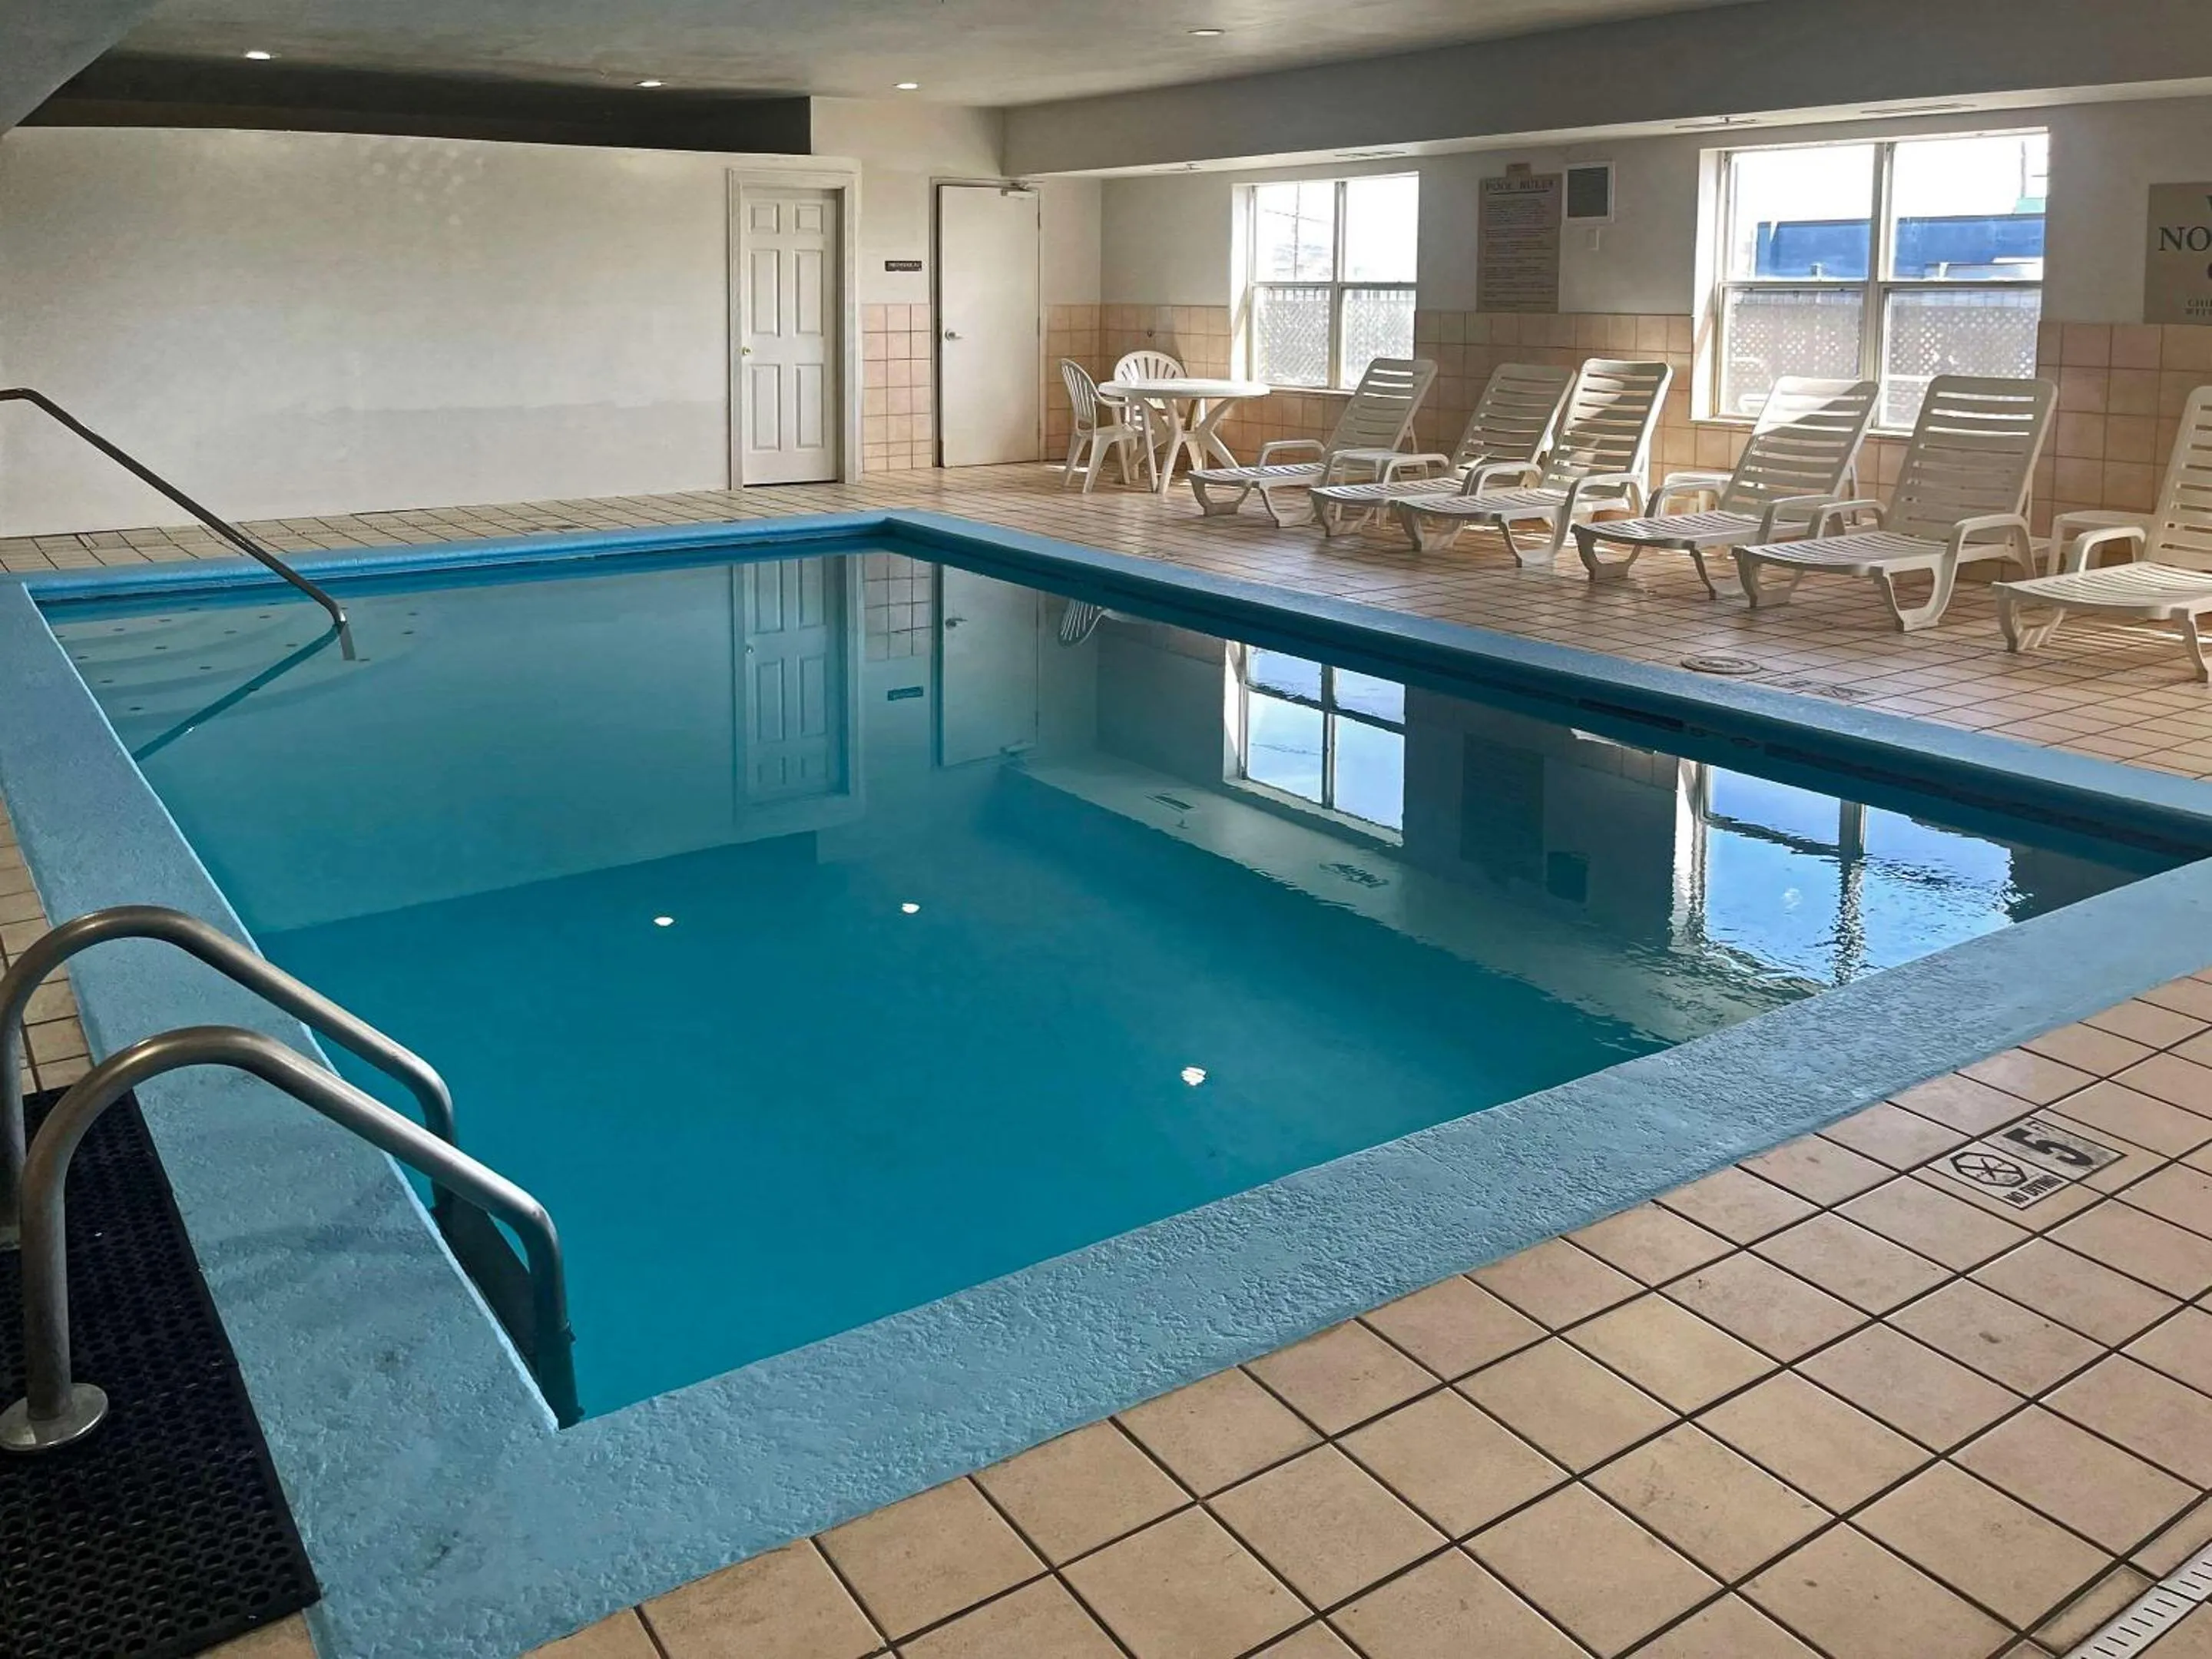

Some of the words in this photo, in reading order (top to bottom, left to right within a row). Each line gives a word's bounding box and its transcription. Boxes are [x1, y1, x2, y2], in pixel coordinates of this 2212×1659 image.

[2158, 226, 2212, 252] NO
[2002, 1128, 2093, 1166] 5
[2003, 1191, 2029, 1204] NO
[2019, 1175, 2064, 1196] DIVING
